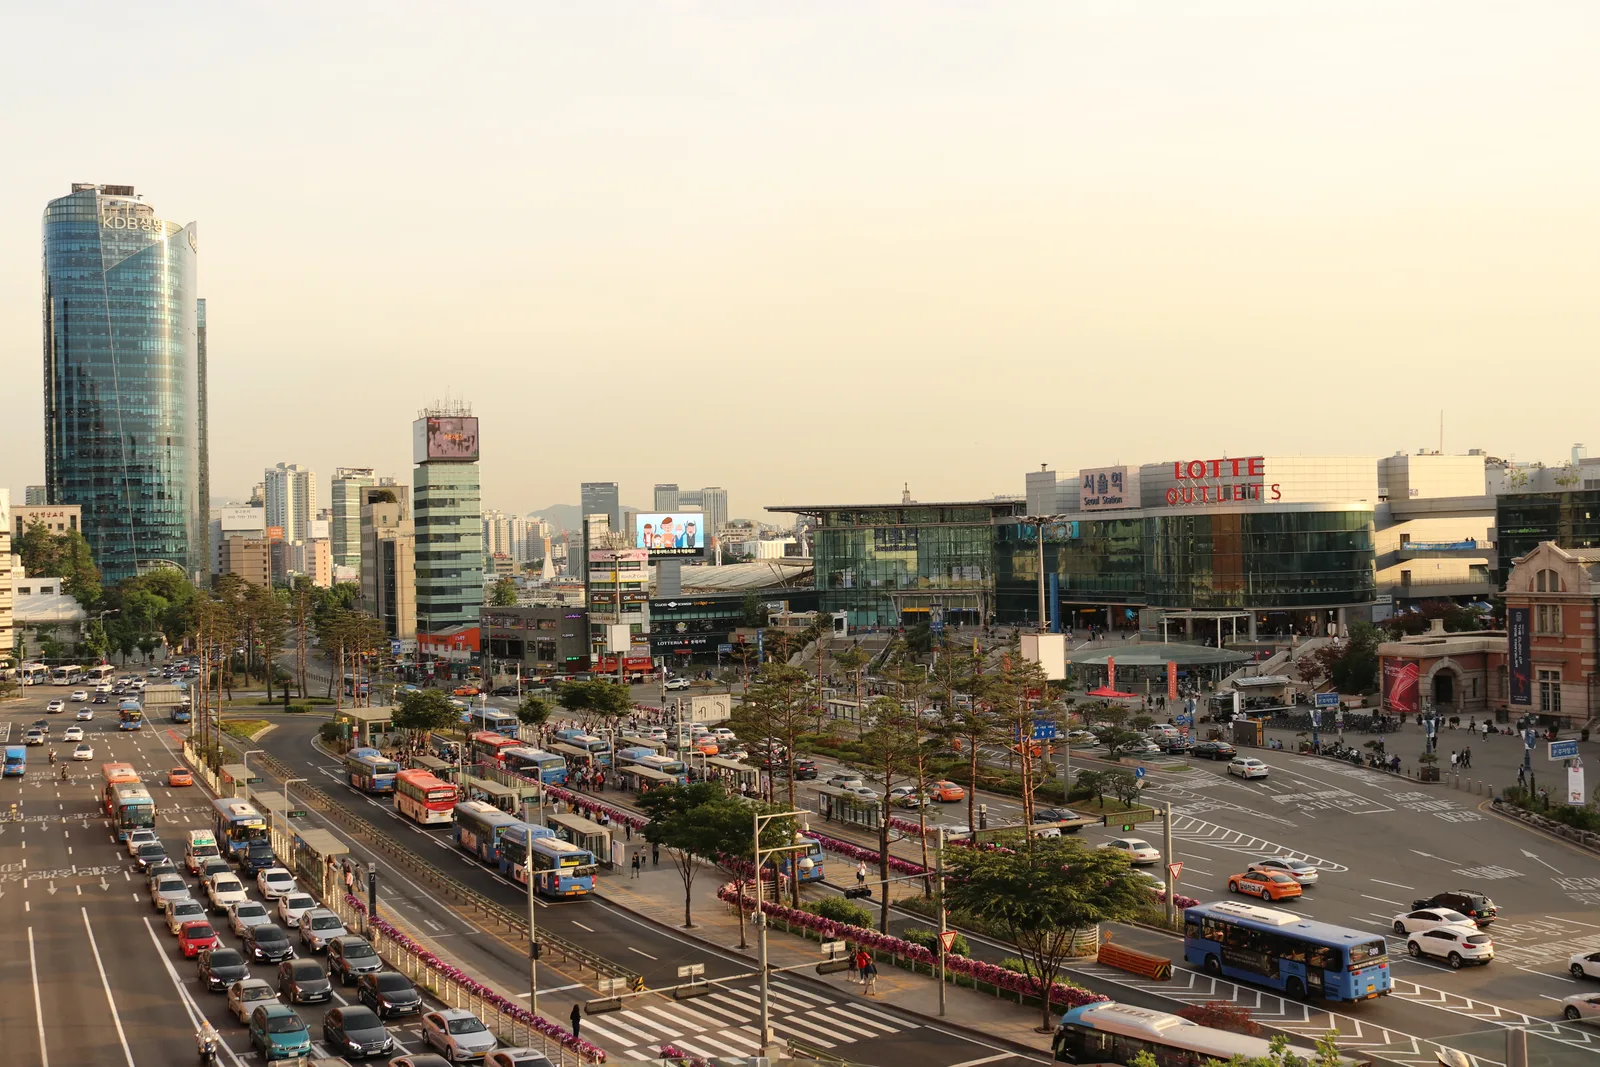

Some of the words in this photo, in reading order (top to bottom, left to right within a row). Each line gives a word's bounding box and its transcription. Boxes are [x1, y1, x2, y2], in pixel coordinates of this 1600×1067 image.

[1174, 457, 1266, 479] LOTTE
[1083, 471, 1123, 495] 서울역
[1083, 496, 1100, 506] Seoul
[1102, 495, 1123, 505] Station
[1165, 484, 1282, 505] OUTLETS
[1369, 947, 1379, 956] 500
